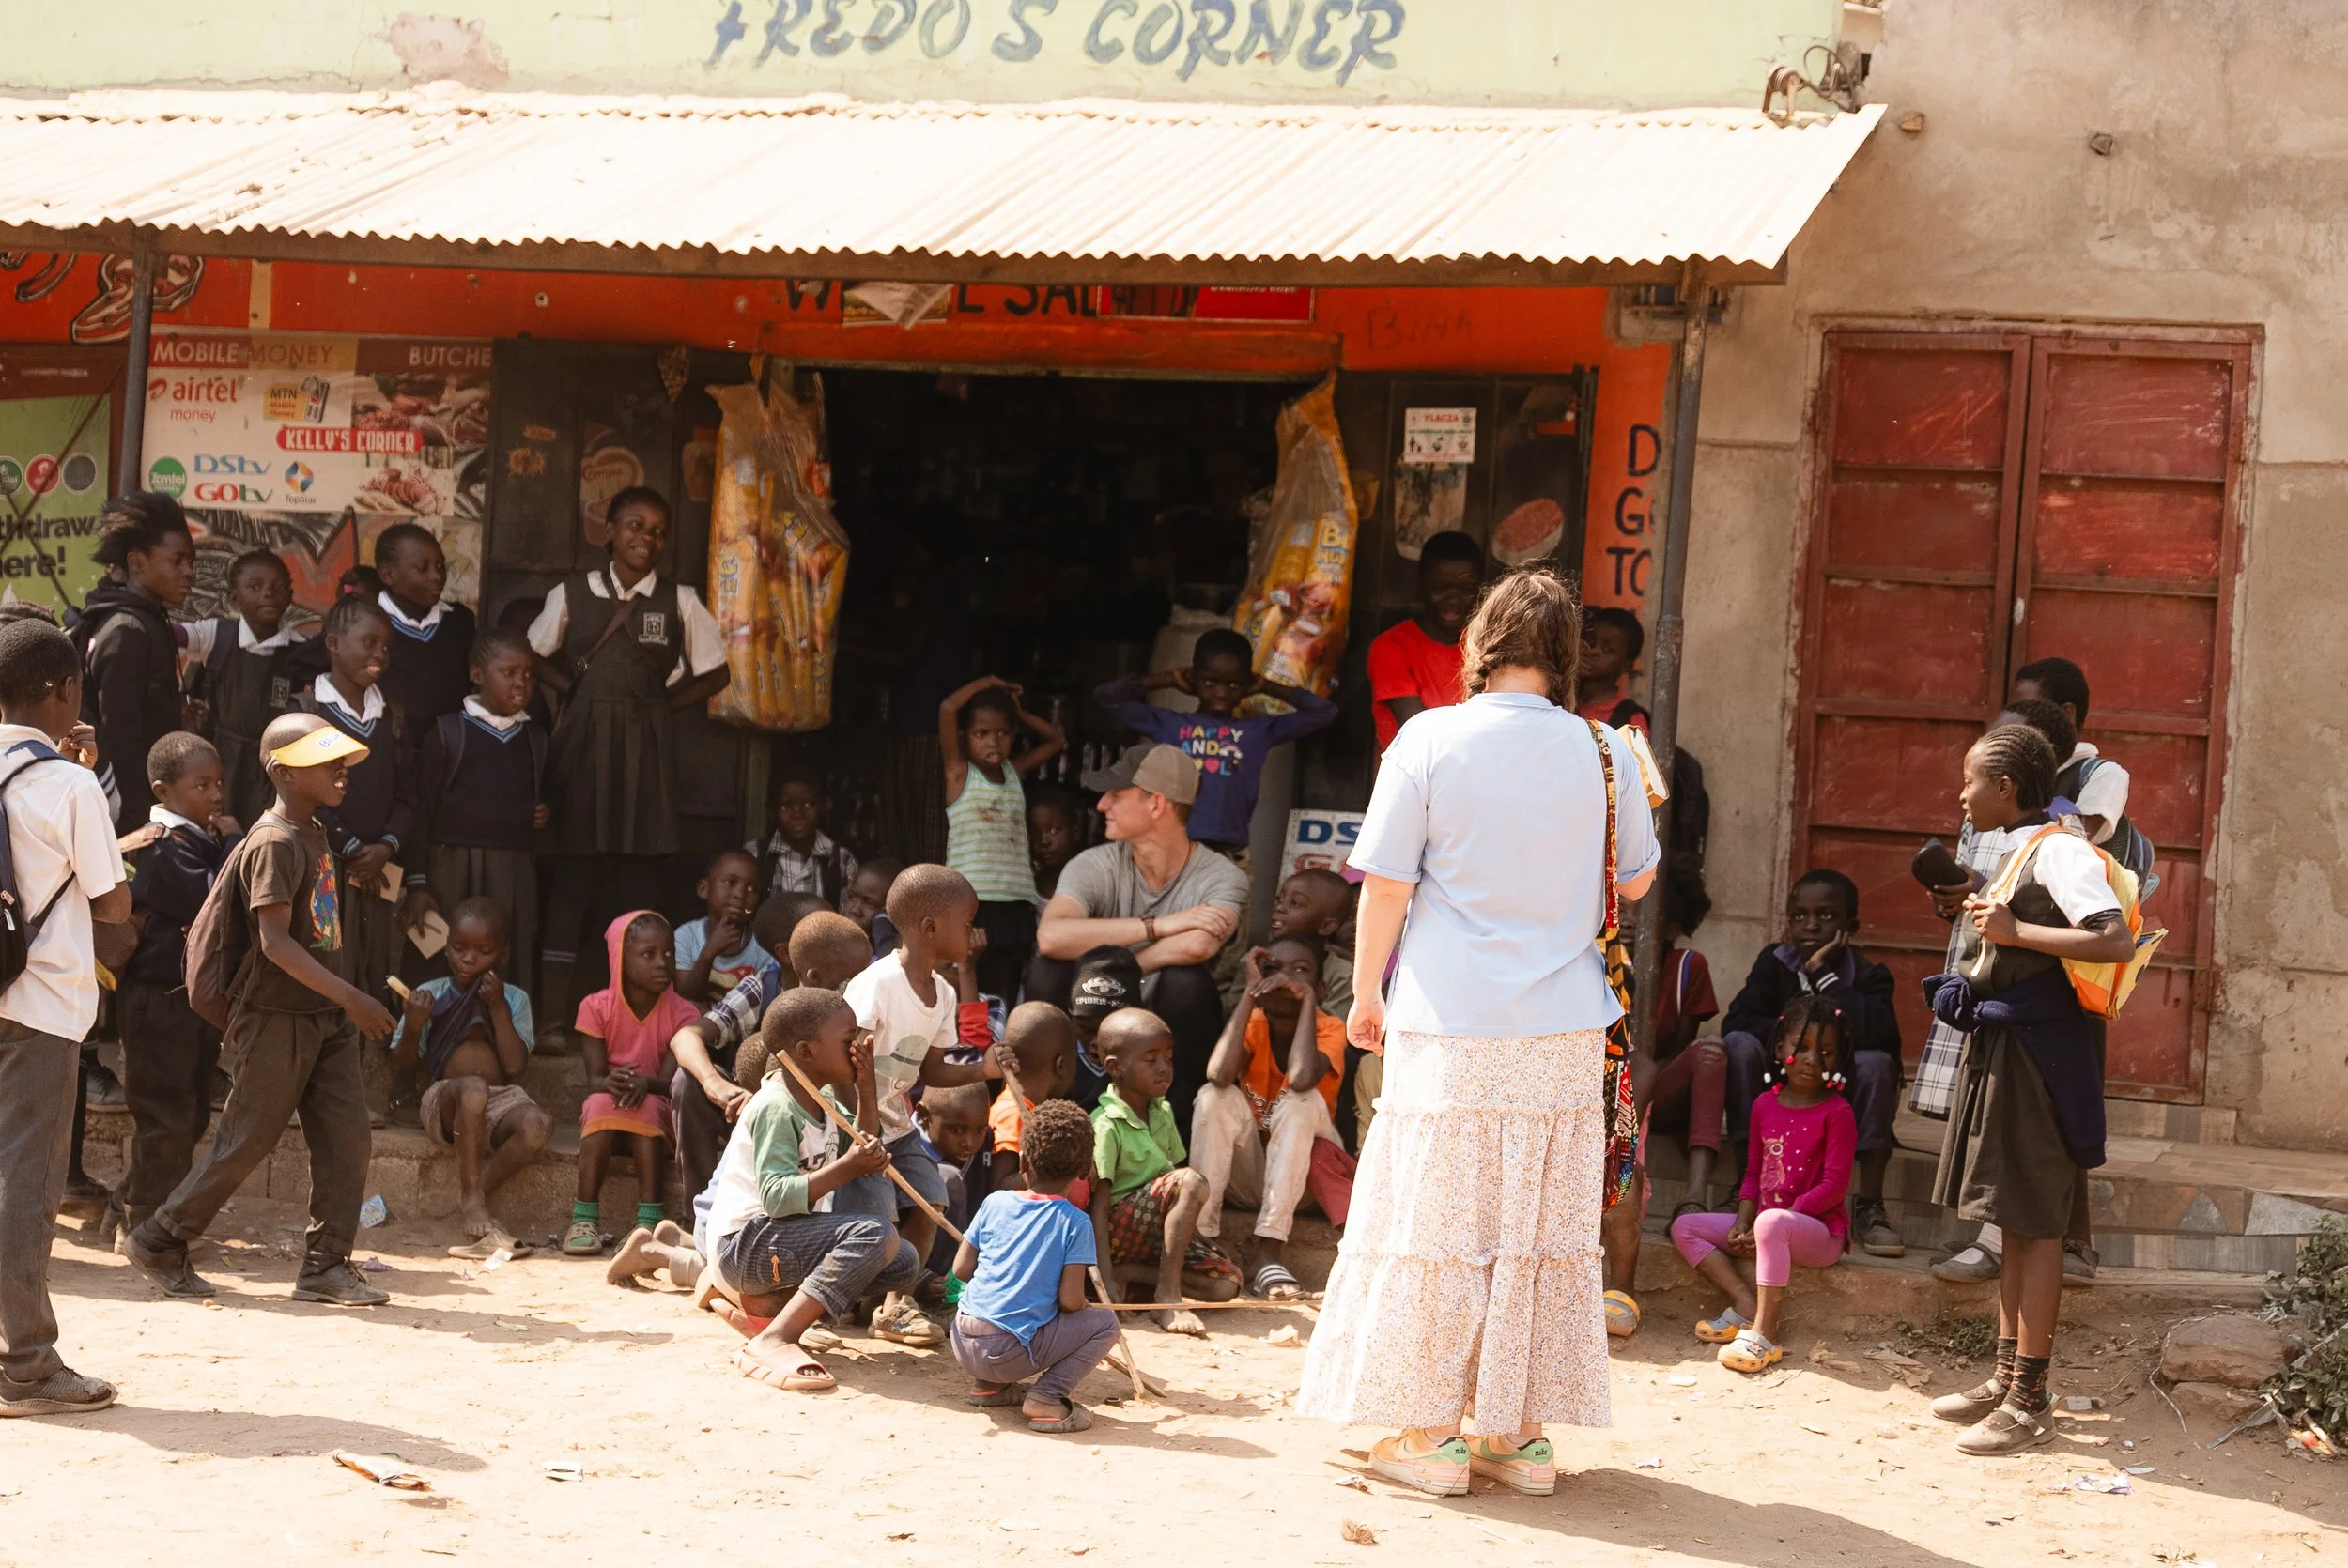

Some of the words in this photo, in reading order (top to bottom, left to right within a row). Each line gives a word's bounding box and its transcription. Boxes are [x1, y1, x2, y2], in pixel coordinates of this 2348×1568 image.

[1082, 0, 1406, 87] CORNER
[153, 341, 239, 364] MOBILE
[247, 344, 333, 366] MONEY
[409, 346, 491, 367] BUTCHE
[172, 377, 238, 403] airtel
[270, 388, 297, 400] MTN
[170, 408, 217, 422] money
[286, 428, 350, 450] KELLY'S
[357, 429, 415, 452] CORNER
[193, 453, 272, 475] DStv
[194, 482, 273, 504] GOtv
[1614, 486, 1657, 536] G
[0, 545, 66, 578] ere!
[1179, 724, 1244, 743] HAPPY
[1181, 739, 1220, 756] AND
[1298, 820, 1364, 846] DS
